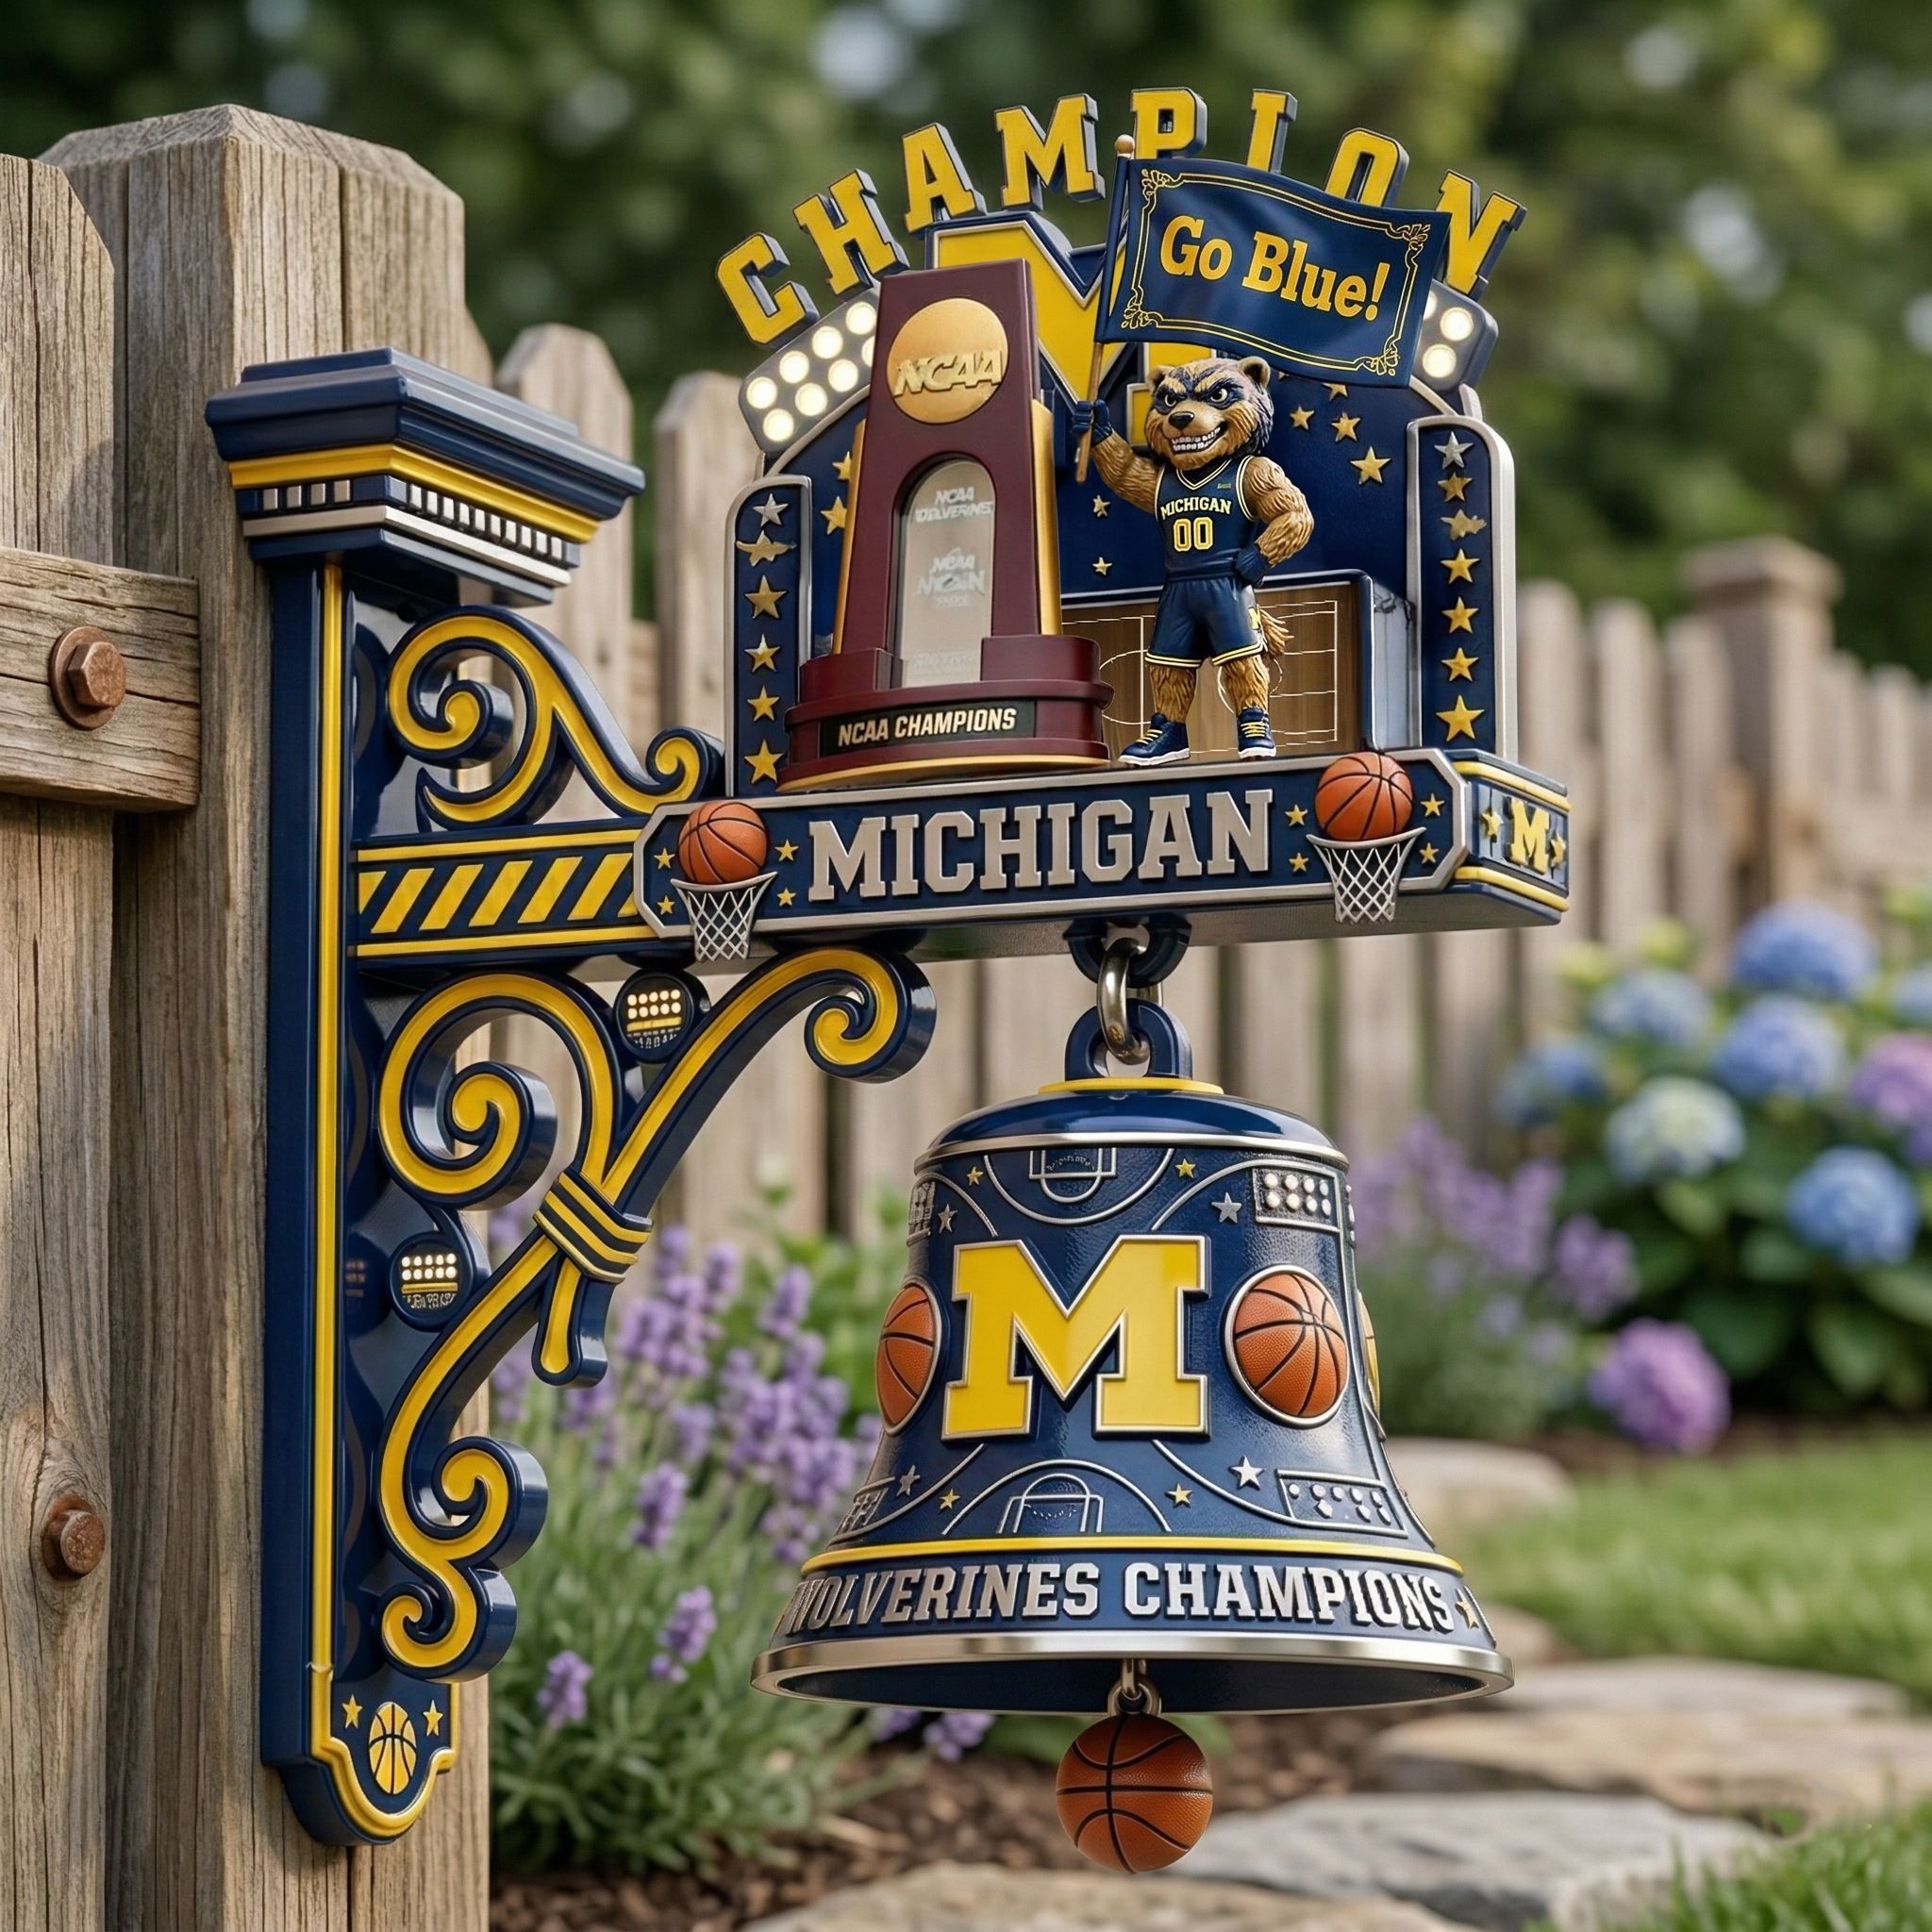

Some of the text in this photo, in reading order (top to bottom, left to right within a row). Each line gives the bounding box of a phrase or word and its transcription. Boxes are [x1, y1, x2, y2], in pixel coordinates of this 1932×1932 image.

[716, 87, 1526, 347] CHAMPION
[1159, 215, 1391, 321] Go Blue!
[893, 350, 1002, 397] NCAA
[1160, 496, 1232, 520] MICHIGAN
[1173, 516, 1214, 552] 00
[838, 708, 1017, 747] NCAA CHAMPIONS
[808, 789, 1274, 901] MICHIGAN
[1508, 796, 1551, 875] M
[941, 1233, 1209, 1440] M
[786, 1561, 1455, 1637] WOLVERINES CHAMPIONS
